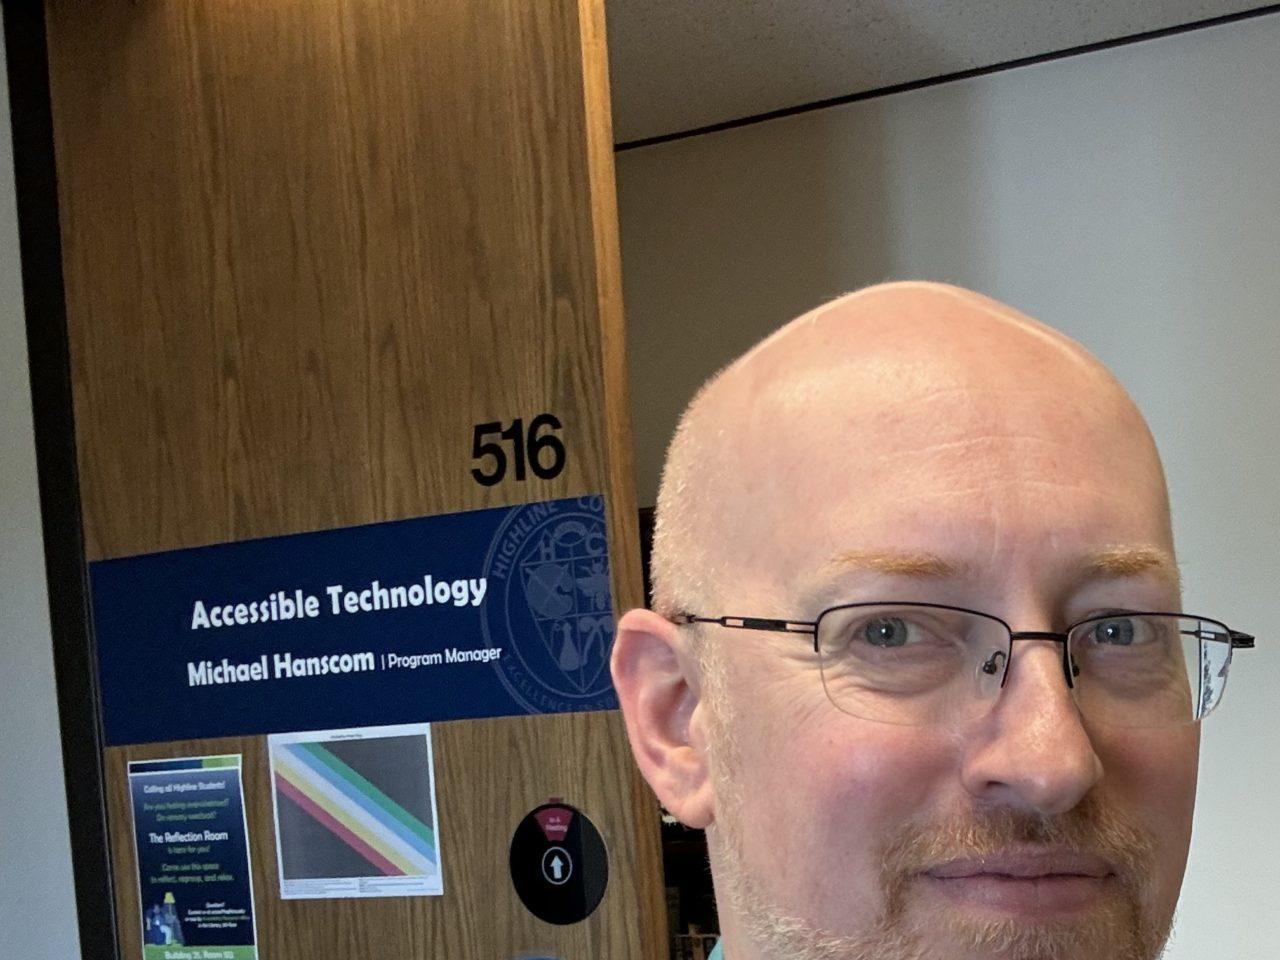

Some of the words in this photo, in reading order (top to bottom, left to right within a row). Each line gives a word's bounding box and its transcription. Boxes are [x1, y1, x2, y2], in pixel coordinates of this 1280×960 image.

[472, 413, 566, 486] 516
[191, 590, 319, 630] Accessible
[326, 575, 487, 607] Technology
[187, 655, 268, 687] Michael
[273, 651, 375, 679] Hanscom
[388, 652, 442, 669] Program
[445, 646, 502, 664] Manager
[149, 833, 163, 843] The
[164, 831, 203, 843] Reflection
[203, 830, 228, 841] Room
